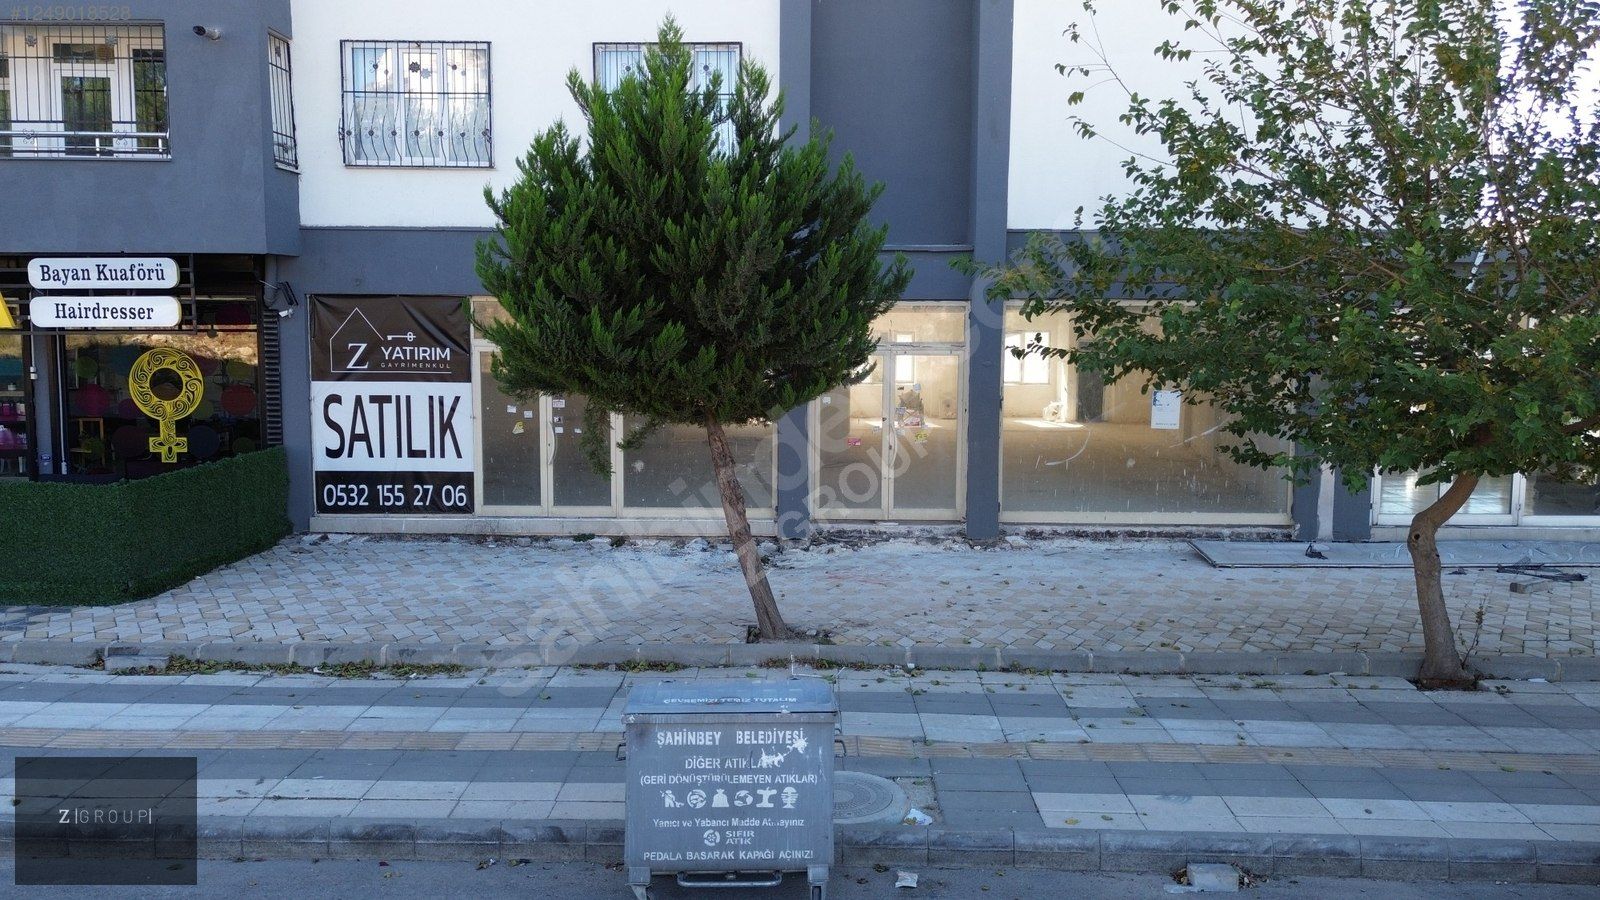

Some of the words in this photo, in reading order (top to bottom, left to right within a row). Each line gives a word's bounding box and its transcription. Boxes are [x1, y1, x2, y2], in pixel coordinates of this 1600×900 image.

[39, 264, 91, 286] Bayan
[95, 263, 166, 282] Kuaförü
[54, 302, 154, 320] Hairdresser
[346, 343, 369, 369] Z
[381, 346, 451, 361] YATIRIM
[323, 393, 463, 459] SATILIK
[323, 484, 369, 506] 0532
[376, 484, 405, 506] 155
[413, 484, 433, 506] 27
[441, 484, 467, 506] 06
[656, 728, 722, 748] ŞAHİNBEY
[736, 727, 804, 745] BELEDİYESİ
[685, 756, 721, 769] DİĞER
[640, 773, 667, 785] (GERİ
[775, 773, 818, 785] ATIKLAR)
[694, 817, 729, 827] Yabancı
[725, 830, 755, 838] SIFIR
[643, 851, 683, 861] PEDALA
[686, 850, 735, 861] BASARAK
[739, 849, 775, 860] KAPAĞI
